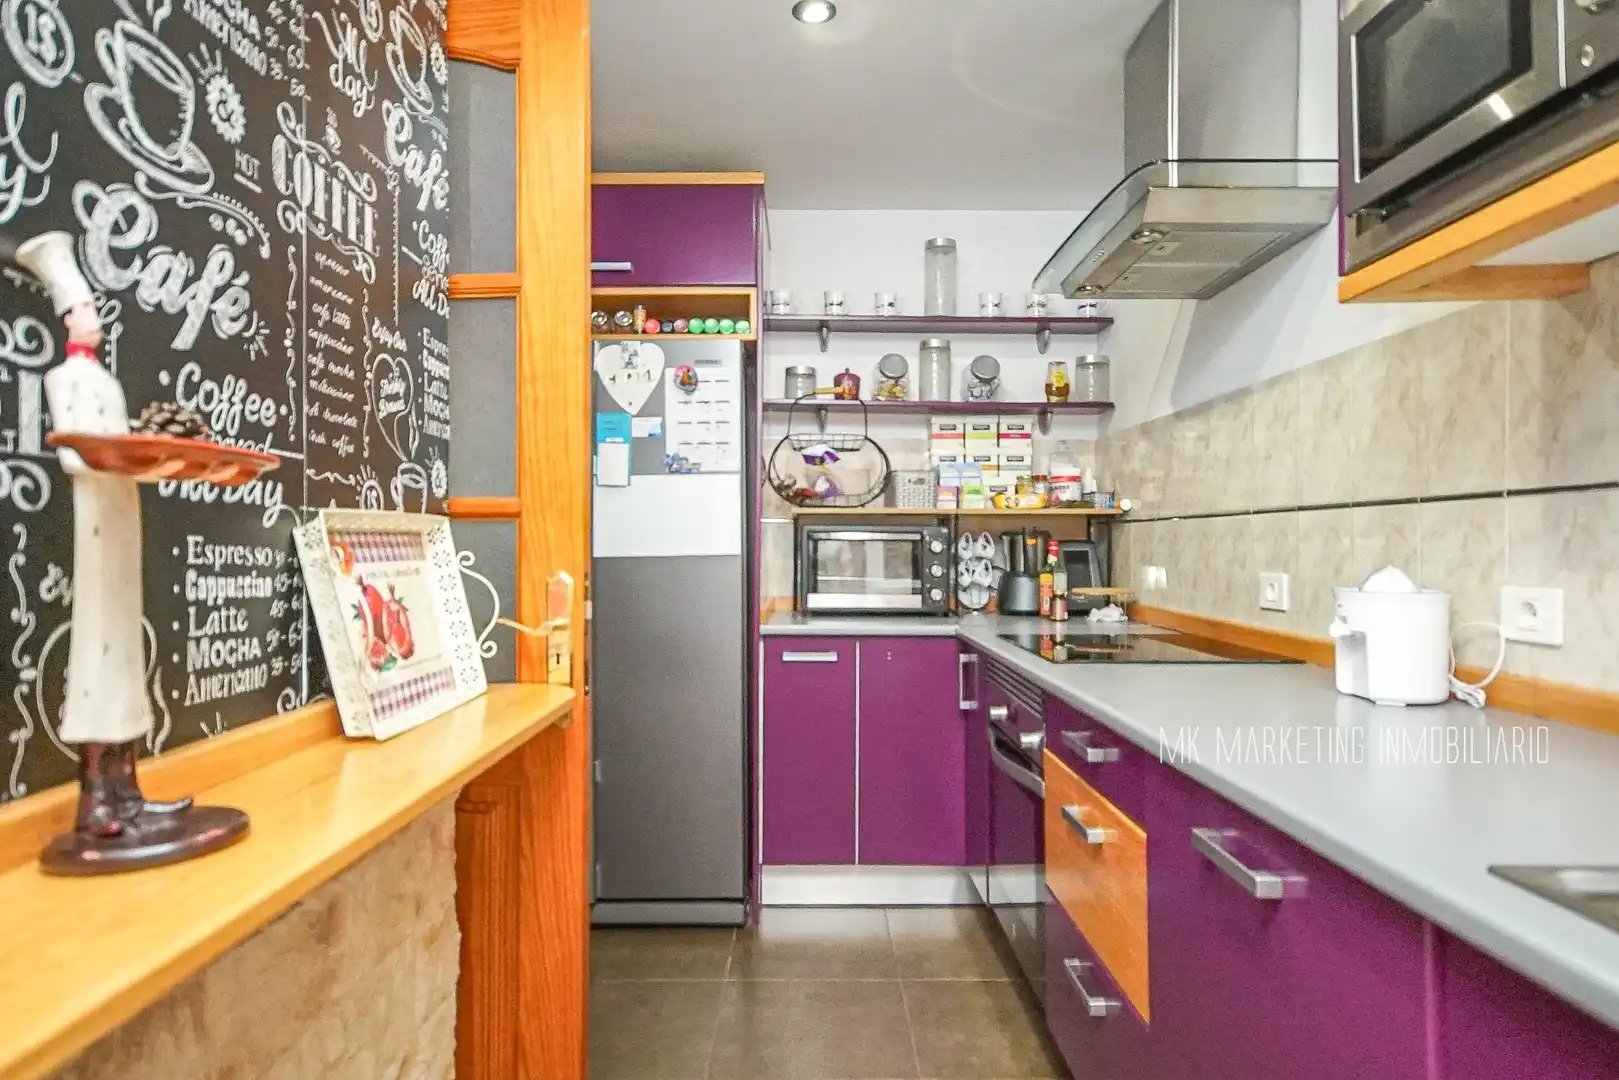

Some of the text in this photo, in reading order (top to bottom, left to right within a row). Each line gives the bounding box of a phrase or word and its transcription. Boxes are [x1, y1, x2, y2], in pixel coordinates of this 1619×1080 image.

[328, 63, 376, 118] day
[235, 148, 261, 181] HOT
[382, 99, 450, 212] Café
[73, 179, 252, 351] Café
[418, 219, 448, 273] Coff
[176, 361, 277, 436] Coffee
[186, 534, 274, 572] Espresso
[185, 568, 273, 607] Cappuccino
[187, 605, 249, 638] Latte
